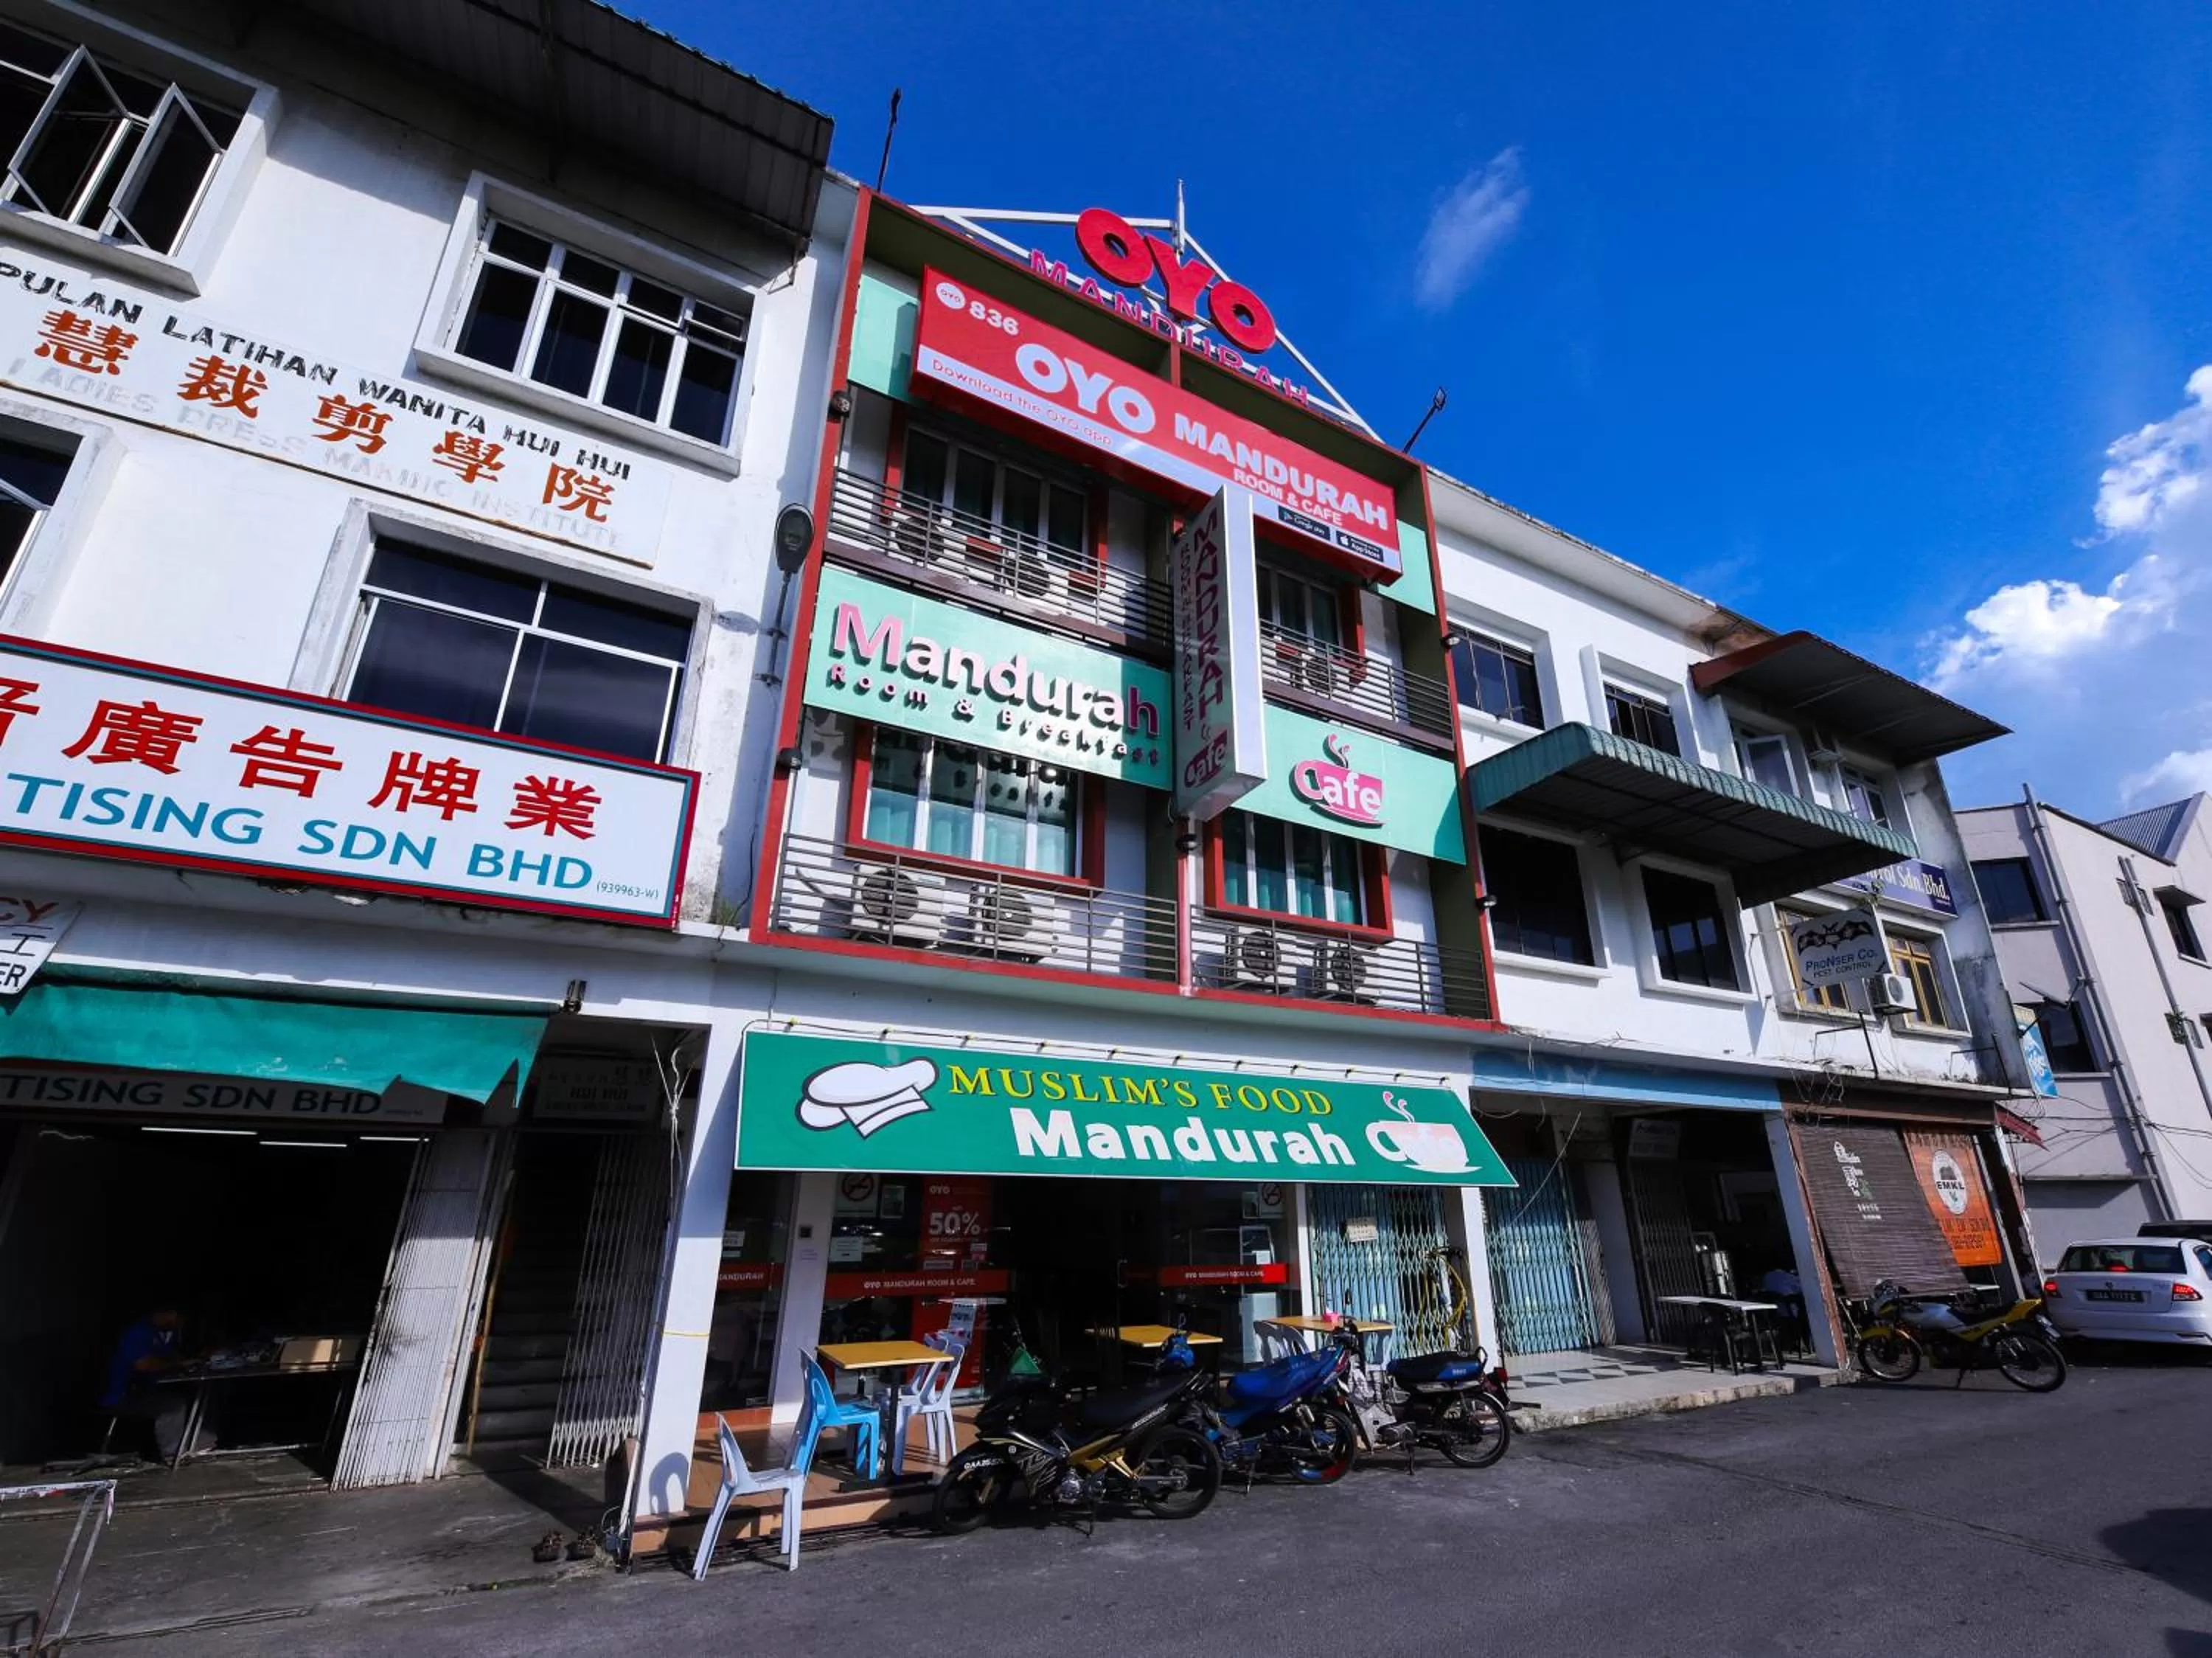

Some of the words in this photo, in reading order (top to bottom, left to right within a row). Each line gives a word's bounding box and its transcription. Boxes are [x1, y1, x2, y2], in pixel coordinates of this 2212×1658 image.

[1074, 207, 1276, 353] OYO
[969, 300, 1019, 336] 836
[1030, 249, 1309, 408] MANDURAH
[34, 309, 615, 523] 慧裁剪學院
[161, 314, 338, 386] LATIHAN
[358, 377, 486, 434] WANITA
[503, 424, 560, 457] HUI
[576, 448, 631, 481] HUI
[932, 358, 1013, 403] Download
[1018, 395, 1040, 414] the
[1046, 409, 1079, 431] OYO
[1082, 426, 1111, 445] app
[1015, 343, 1156, 434] OYO
[1174, 412, 1388, 531] MANDURAH
[1234, 468, 1283, 501] ROOM
[1287, 492, 1298, 509] &
[1301, 499, 1344, 527] CAFE
[1194, 507, 1224, 721] MANDURAH
[830, 663, 928, 707] Room
[956, 698, 974, 718] &
[831, 601, 1159, 736] Mandurah
[1184, 740, 1228, 788] Cafe
[1293, 759, 1382, 816] Cafe
[7, 772, 265, 844] TISING
[297, 819, 437, 870] SDN
[466, 843, 594, 889] BHD
[596, 882, 659, 900] (939963-W)
[1921, 873, 1951, 901] Bhd.
[182, 1083, 276, 1111] SDN
[291, 1087, 382, 1114] BHD
[946, 1064, 1199, 1108] MUSLIM'S
[1206, 1083, 1334, 1116] FOOD
[1009, 1106, 1357, 1166] Mandurah
[928, 1210, 981, 1236] 50%
[719, 1272, 765, 1282] ANDURAH
